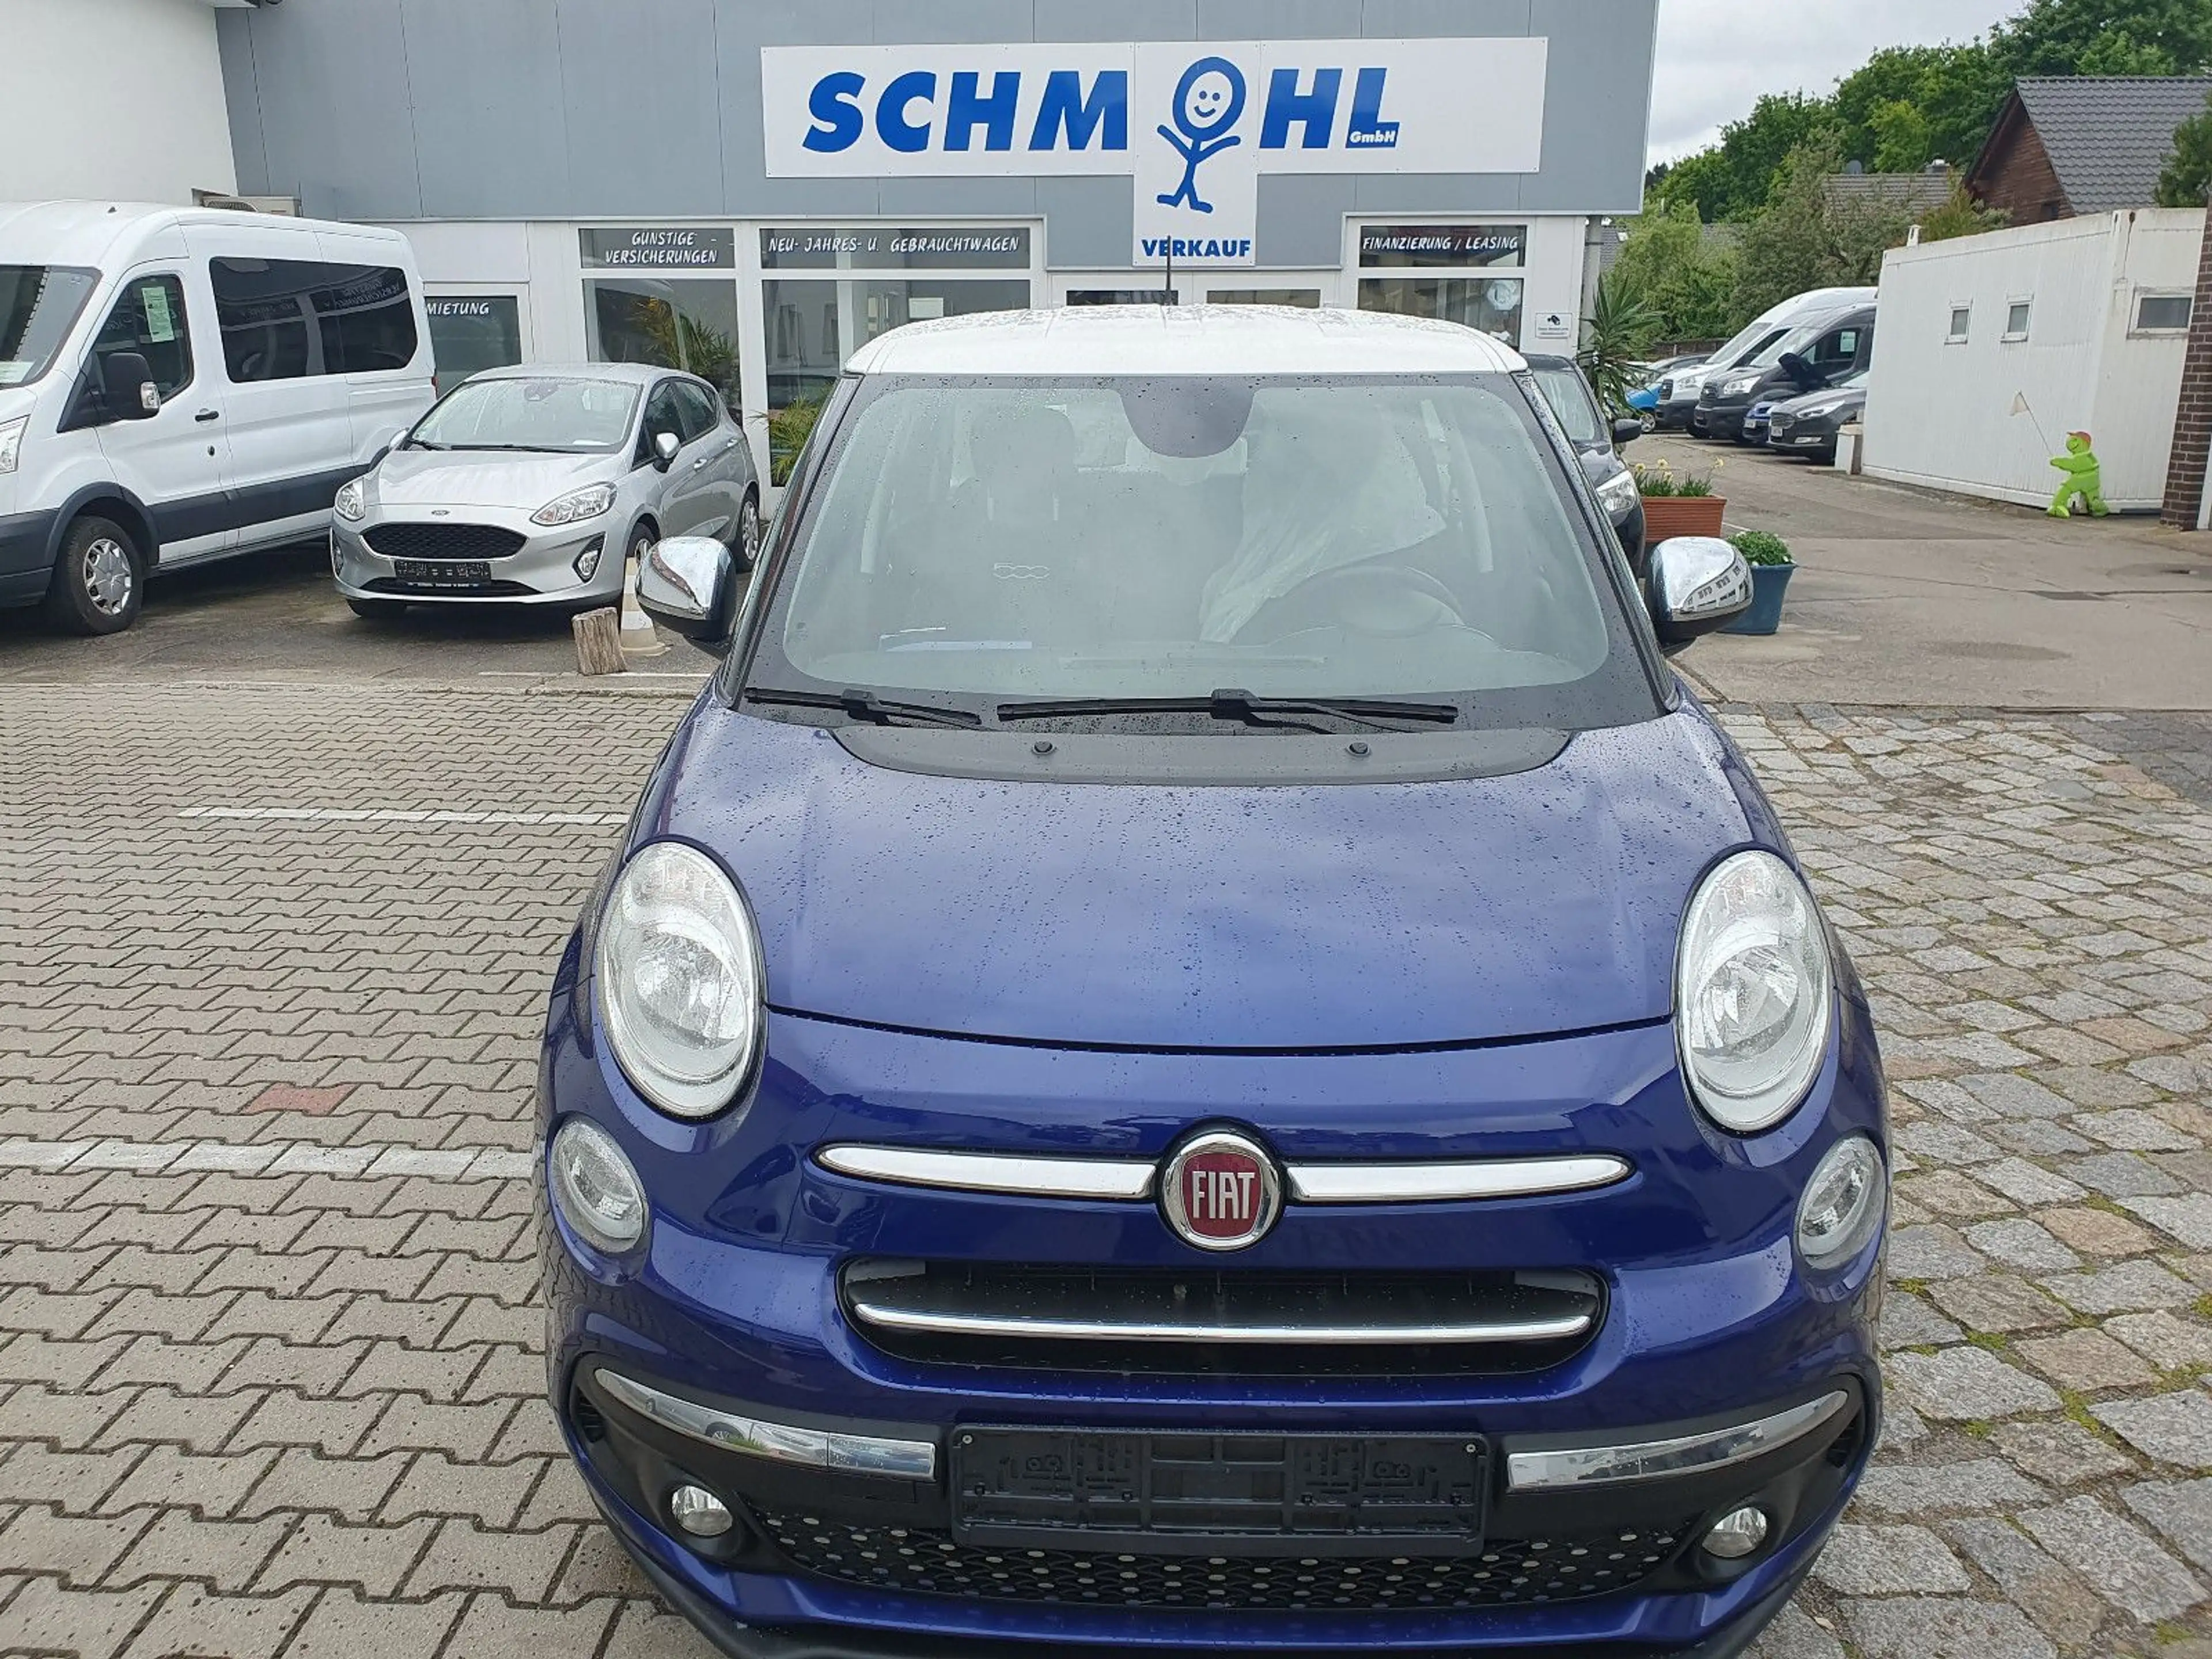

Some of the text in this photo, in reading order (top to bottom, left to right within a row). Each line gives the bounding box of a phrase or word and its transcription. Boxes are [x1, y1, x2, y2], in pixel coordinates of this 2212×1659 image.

[1349, 130, 1396, 143] GmbH
[768, 237, 1020, 252] NEU- JAHRES- U. GEBRAUCHTWAGEN
[1141, 239, 1251, 257] VERKAUF
[1362, 236, 1451, 250] FINANZIERUNG
[1465, 236, 1518, 249] LEASING
[605, 249, 717, 264] VERSICHERUNGEN
[1192, 1171, 1256, 1219] FIAT
